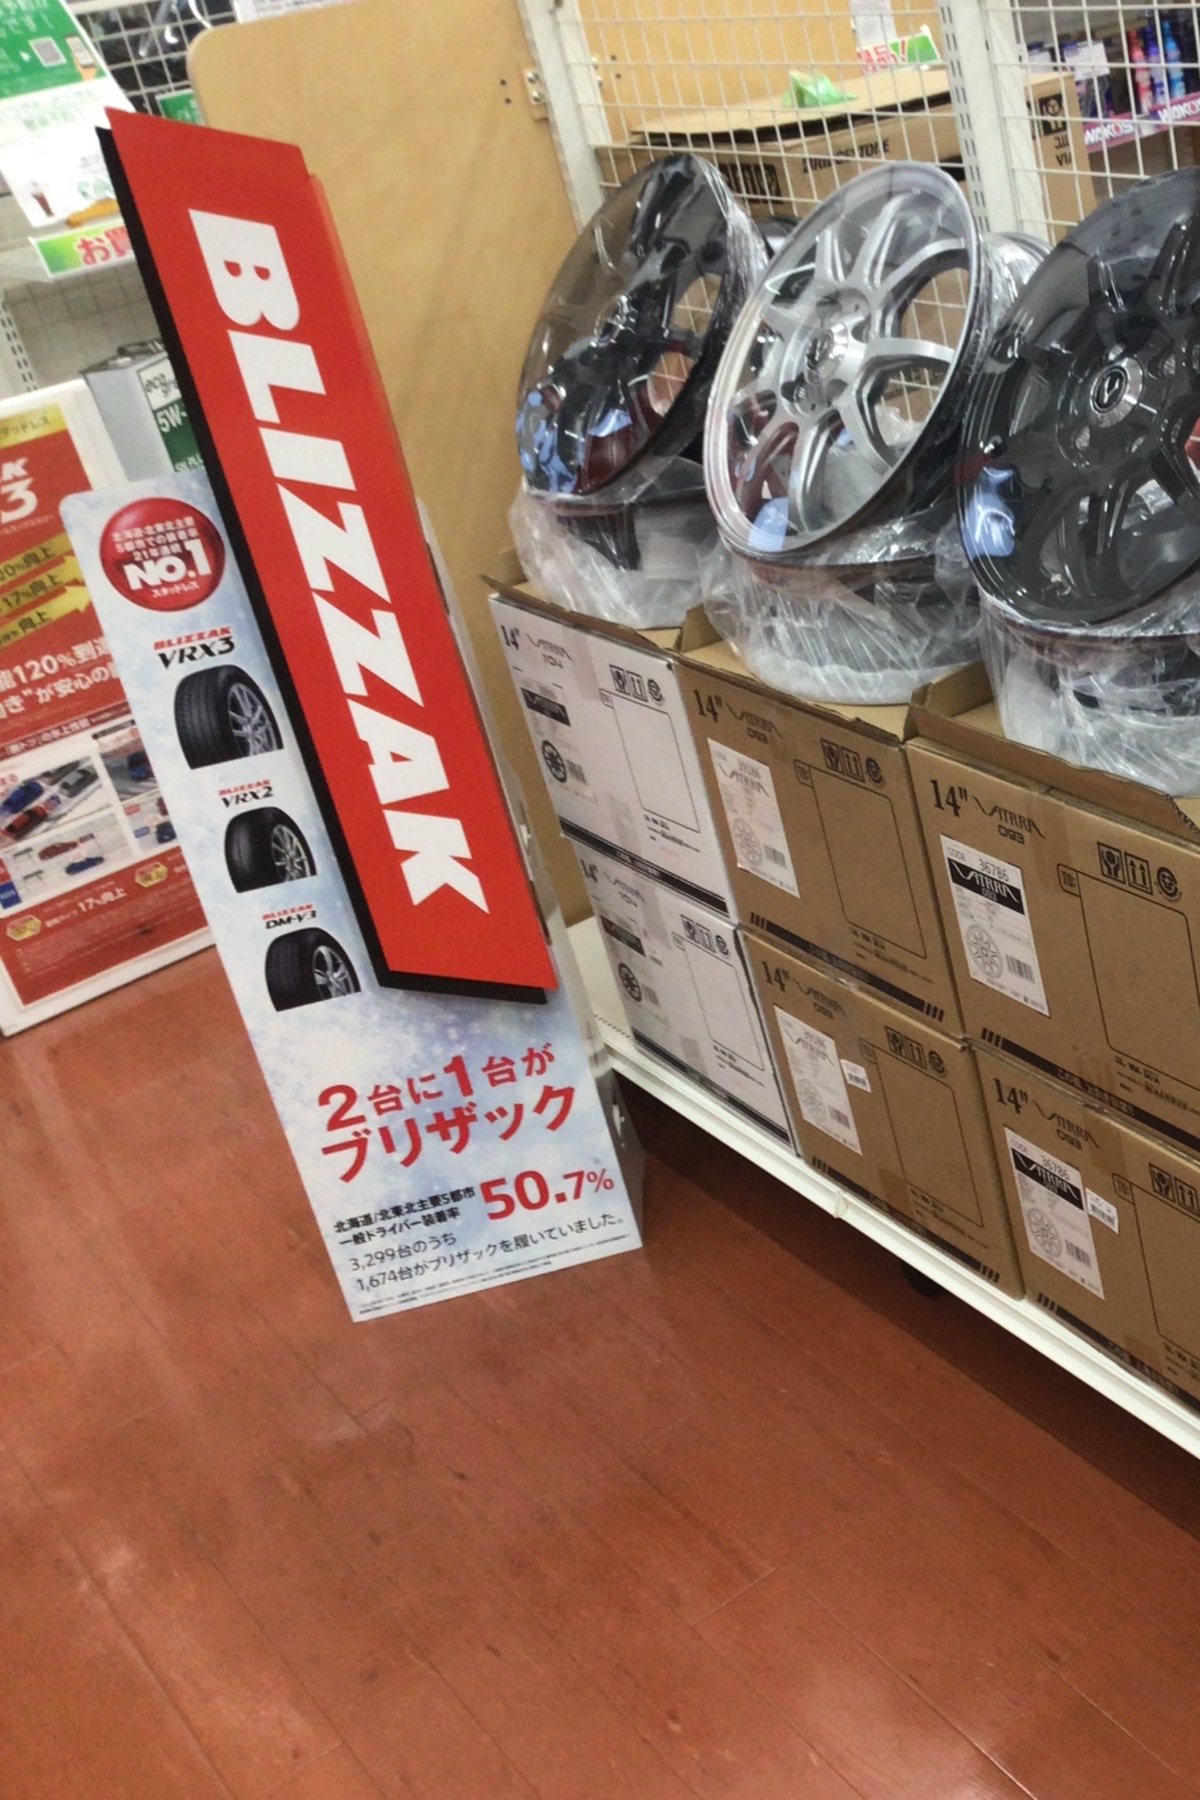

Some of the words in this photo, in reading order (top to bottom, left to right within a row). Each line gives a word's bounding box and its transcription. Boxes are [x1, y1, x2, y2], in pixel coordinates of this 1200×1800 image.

[123, 538, 212, 591] NO.1
[189, 208, 490, 915] BLIZZAK
[154, 625, 232, 650] BLIZZAK
[158, 636, 235, 669] VRX3
[218, 779, 271, 797] BLIZZAK
[221, 786, 274, 808] VRX2
[978, 858, 1010, 882] 36786
[262, 903, 313, 920] BLIZZAK
[265, 910, 317, 929] DM-V3
[318, 1042, 556, 1132] 2台に1台が
[321, 1084, 576, 1184] ブリザック
[479, 1168, 615, 1221] 50.7%
[338, 1206, 461, 1245] 一般ドライバー装着率
[349, 1232, 457, 1271] 3,299台のうち
